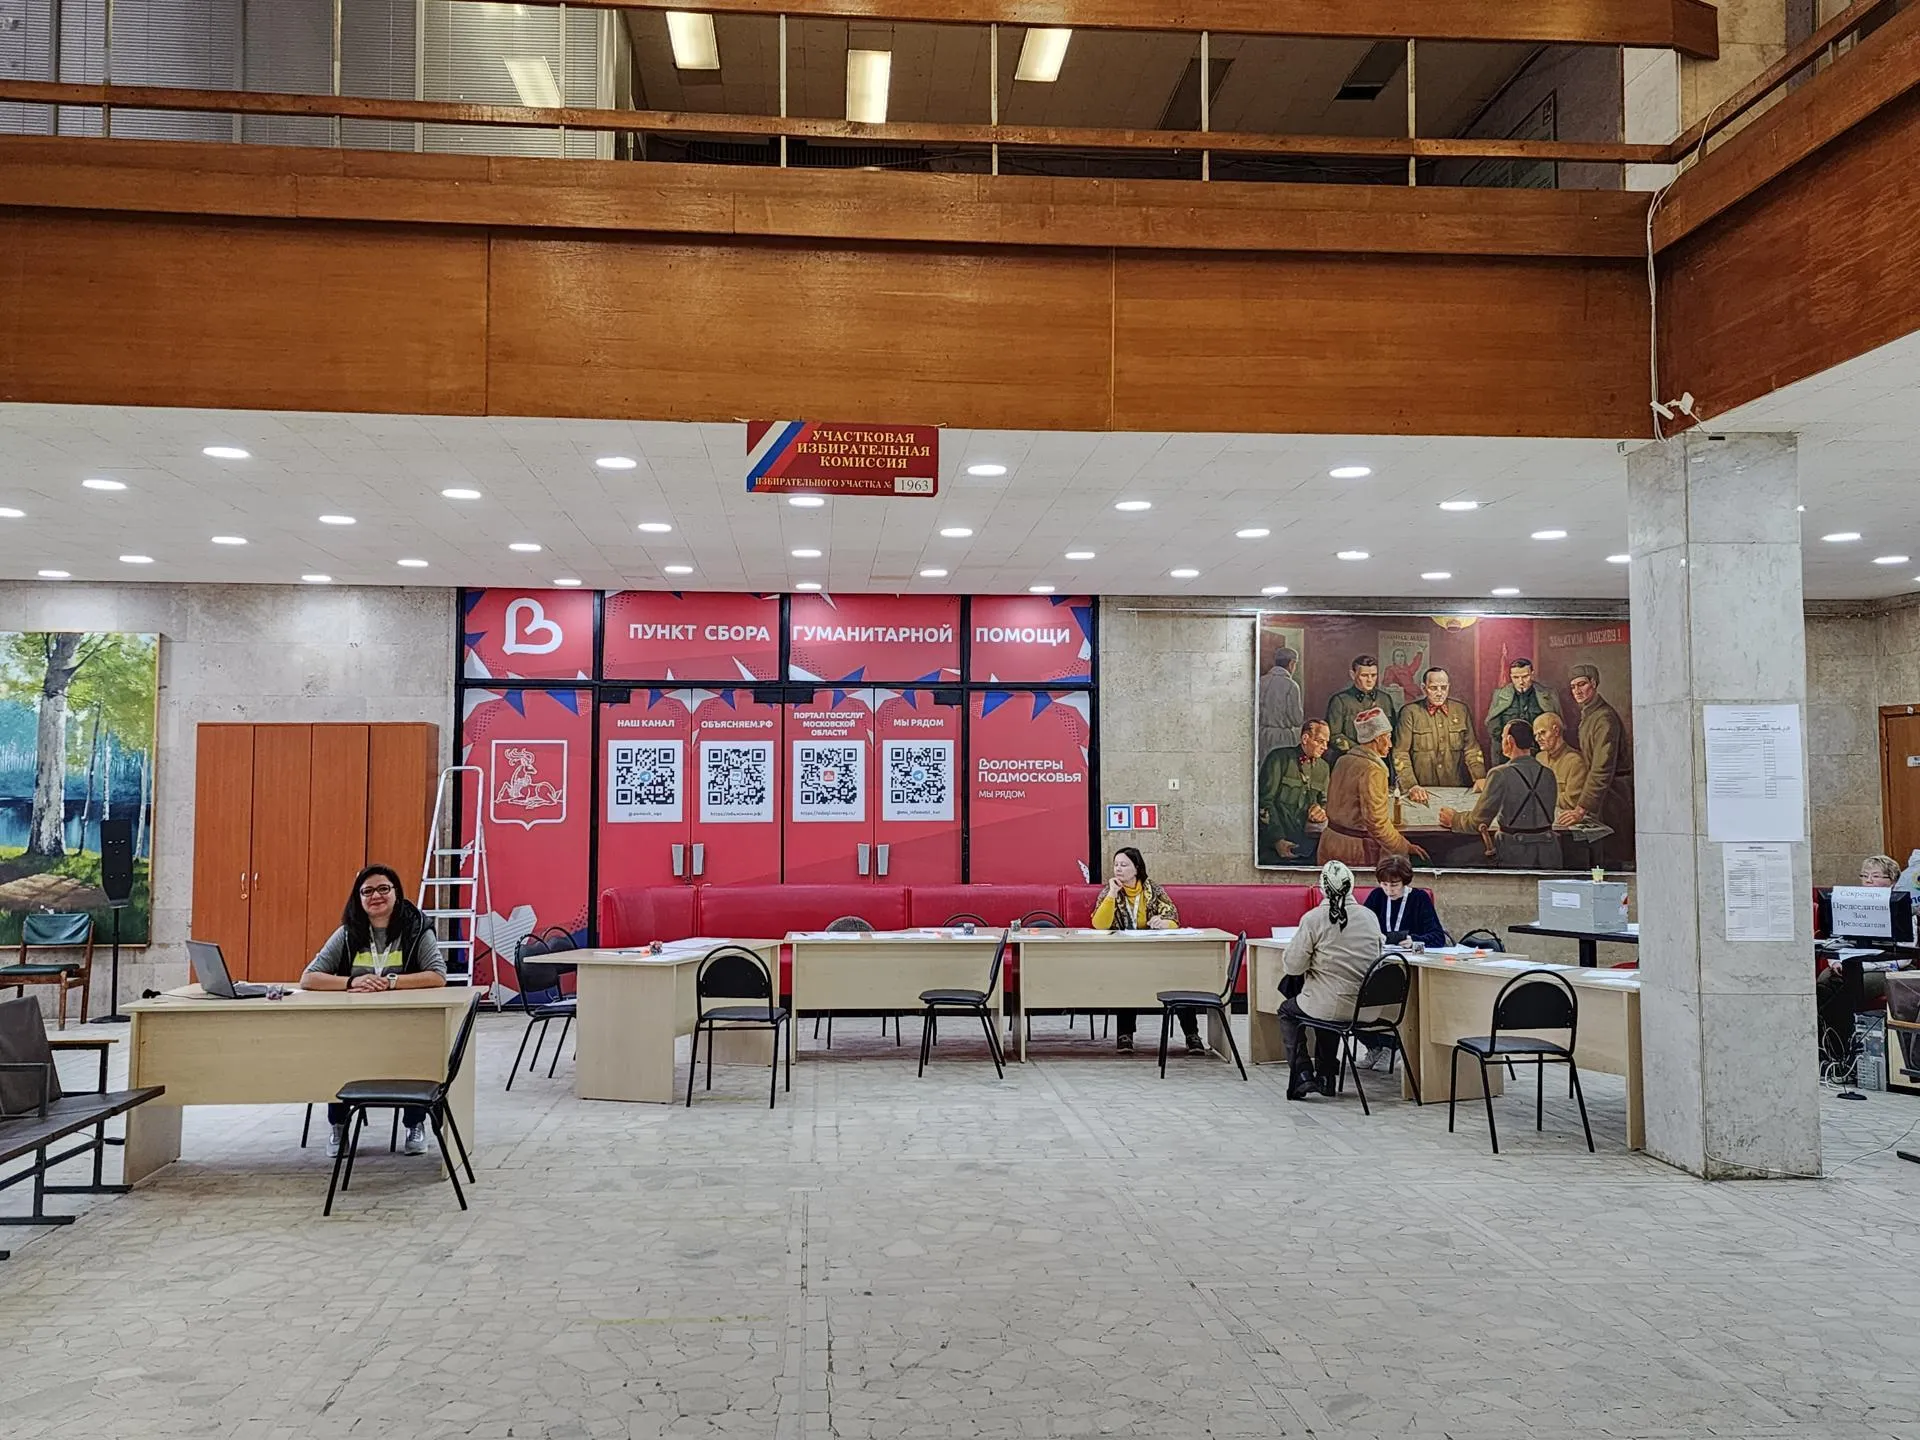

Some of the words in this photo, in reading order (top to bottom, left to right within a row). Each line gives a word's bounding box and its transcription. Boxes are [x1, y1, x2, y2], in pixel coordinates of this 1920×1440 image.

[812, 430, 915, 444] УЧАСТКОВАЯ
[797, 443, 931, 457] ИЗБИРАТЕЛЬНАЯ
[820, 456, 908, 469] КОМИССИЯ
[755, 477, 838, 488] ИЗБИРАТЕЛЬНОГО
[840, 478, 882, 489] УЧАСТКА
[899, 479, 929, 492] 1963
[629, 623, 697, 641] ПУНКТ
[704, 624, 771, 642] СБОРА
[792, 624, 953, 643] ГУМАНИТАРНОЙ
[975, 627, 1070, 646] ПОМОЩИ
[793, 712, 826, 720] ПОРТАЛ
[826, 711, 865, 720] ГОСУСЛУГ
[617, 719, 640, 728] НАШ
[642, 719, 675, 728] КАНАЛ
[701, 720, 774, 728] ОБЪЯСНЯЕМ.РФ
[802, 719, 856, 728] МОСКОВСКОЙ
[893, 718, 910, 727] МЫ
[911, 718, 945, 729] РЯДОМ
[811, 729, 848, 737] ОБЛАСТИ
[978, 790, 994, 798] МЫ
[995, 790, 1026, 799] РЯДОМ
[1832, 902, 1889, 911] Председатель
